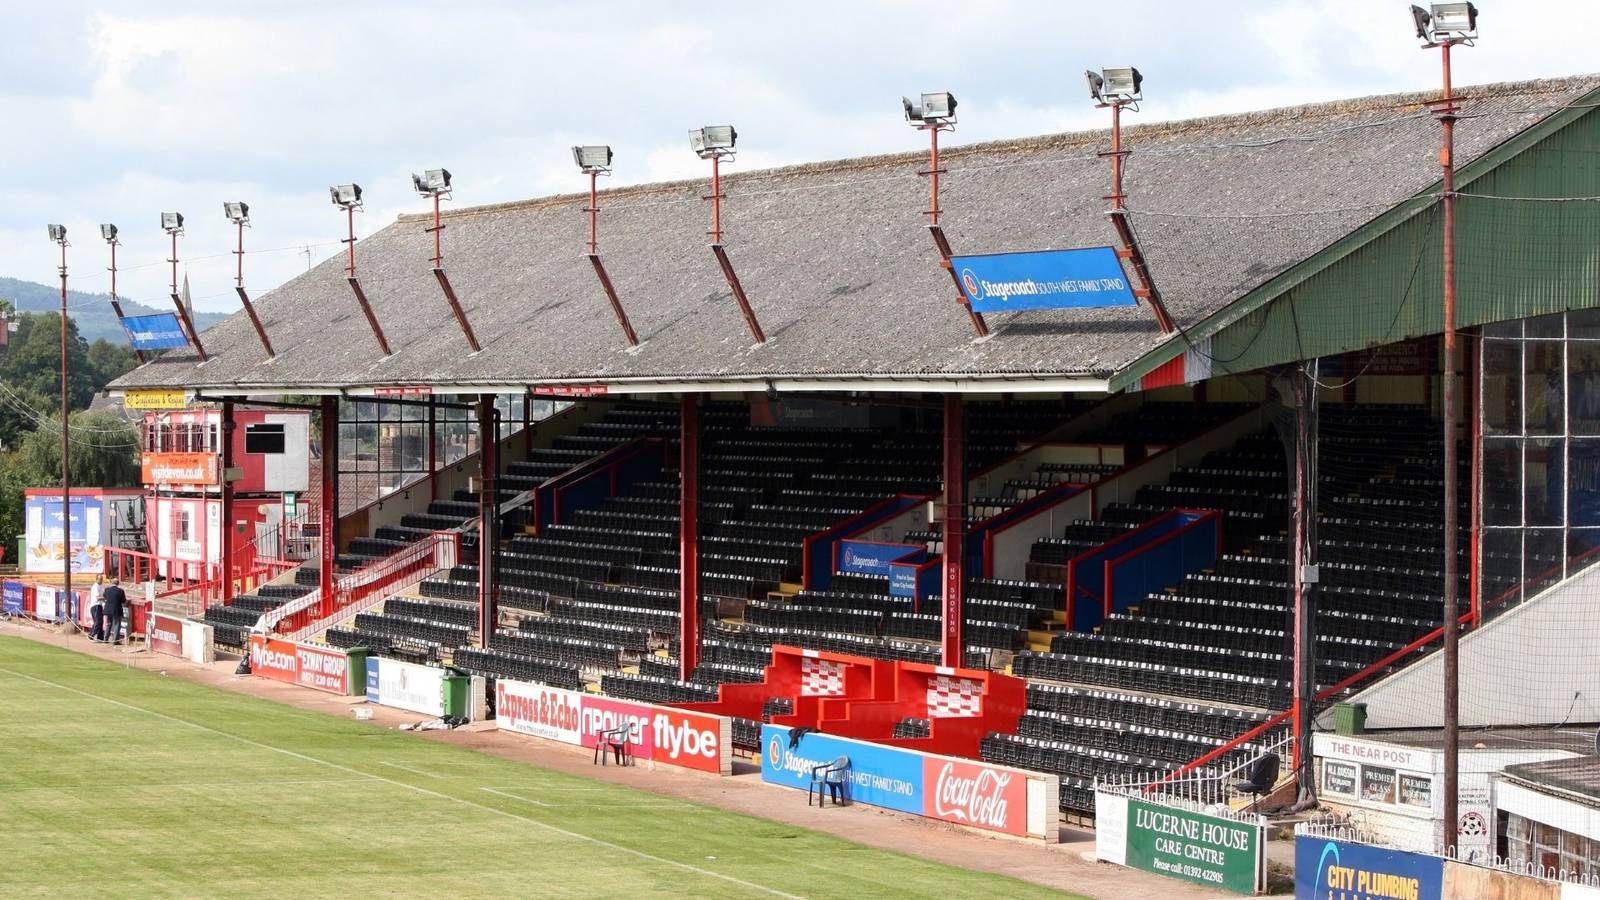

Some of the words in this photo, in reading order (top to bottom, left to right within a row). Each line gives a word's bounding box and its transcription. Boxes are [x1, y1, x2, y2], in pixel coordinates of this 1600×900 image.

[982, 279, 1037, 301] Stagecoach
[1038, 282, 1058, 294] SOUTH
[1059, 281, 1077, 293] WEST
[1078, 280, 1100, 292] FAMILY
[1101, 278, 1123, 291] STAND
[653, 713, 717, 759] flybe
[1331, 742, 1350, 756] THE
[1352, 745, 1382, 760] NEAR
[1384, 750, 1412, 765] POST
[872, 775, 893, 792] FAMILY
[893, 780, 914, 796] STAND
[935, 762, 1011, 828] Coca-Cola
[1136, 808, 1200, 841] LUCERNE
[1202, 823, 1249, 851] HOUSE
[1155, 837, 1182, 856] CARE
[1184, 844, 1225, 866] CENTRE
[1153, 858, 1171, 872] Please
[1184, 865, 1201, 880] 01392
[1328, 864, 1355, 891] CITY
[1357, 870, 1419, 900] PLUMBING
